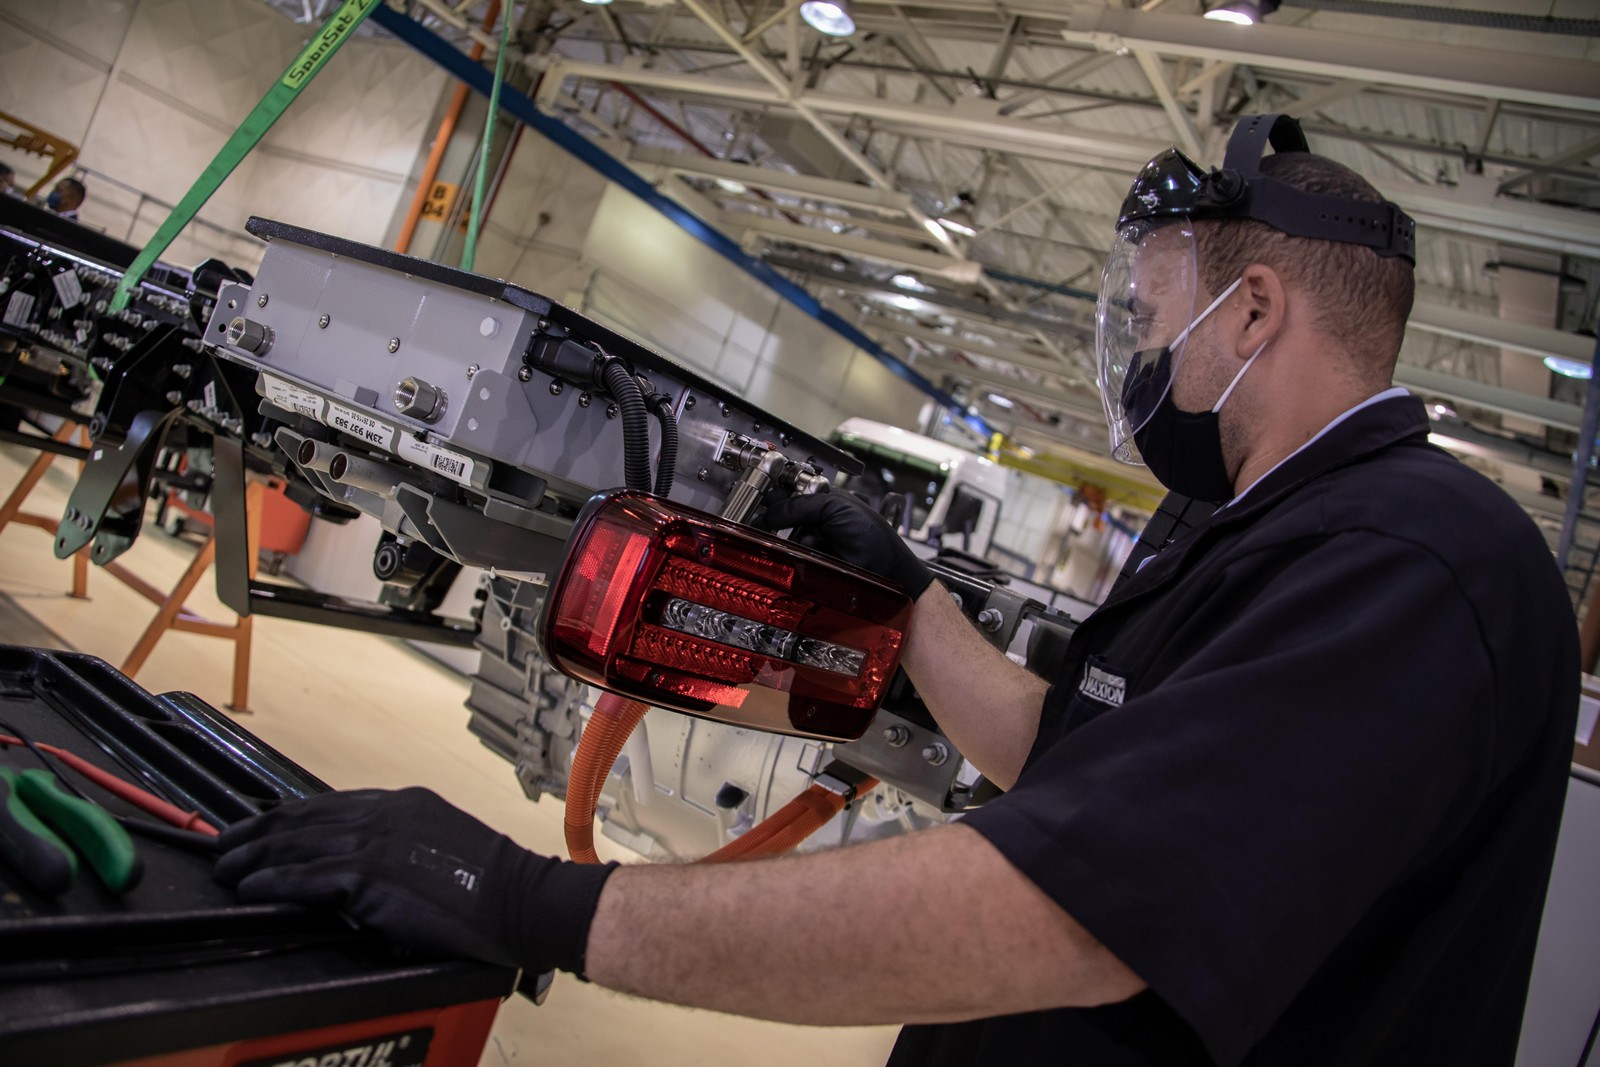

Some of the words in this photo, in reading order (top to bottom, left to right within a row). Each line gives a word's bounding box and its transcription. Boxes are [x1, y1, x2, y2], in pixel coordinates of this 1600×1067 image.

[335, 416, 349, 429] 583
[350, 423, 364, 436] 937
[365, 429, 383, 445] 23M
